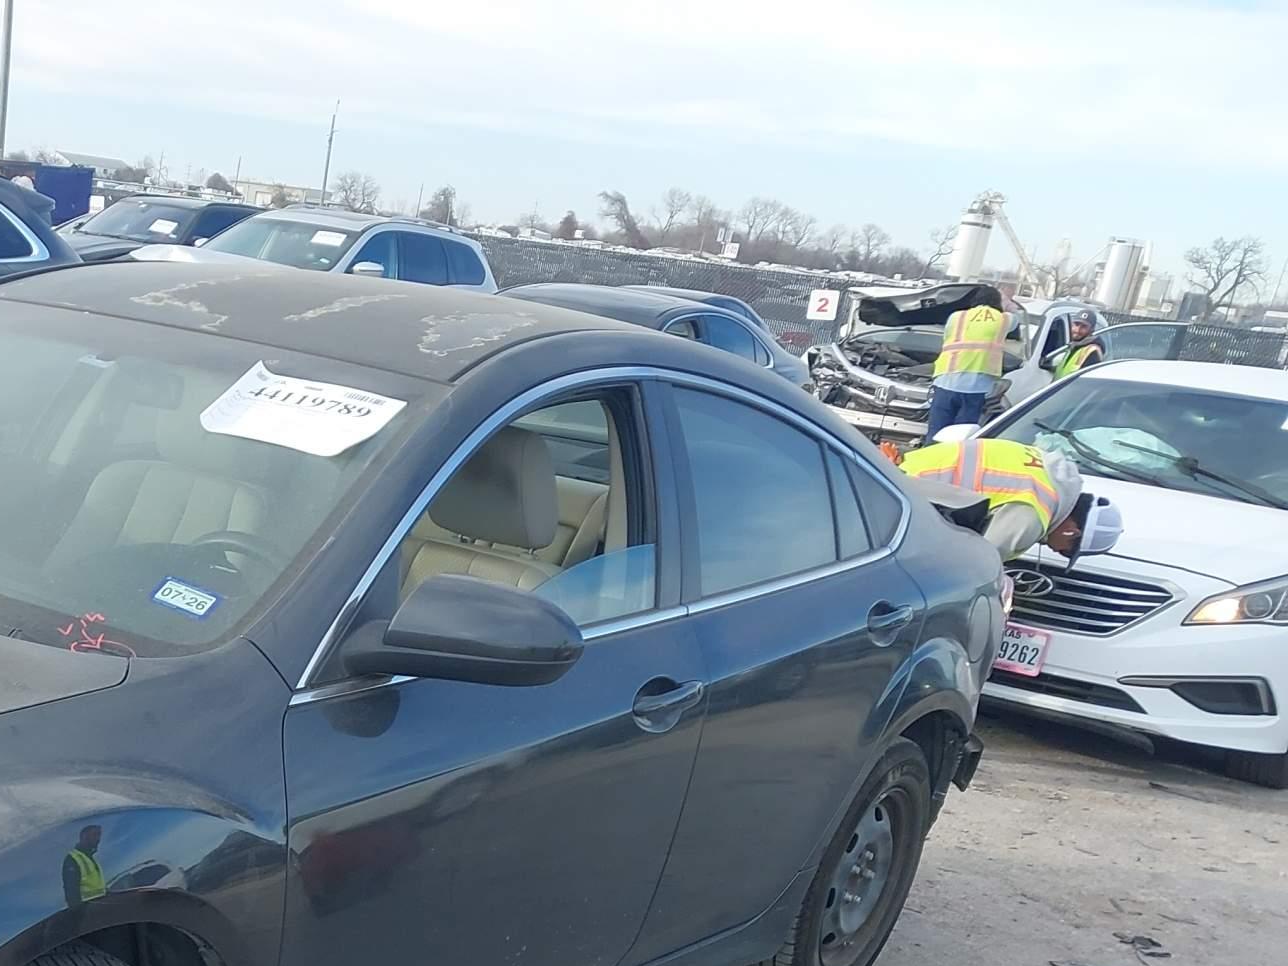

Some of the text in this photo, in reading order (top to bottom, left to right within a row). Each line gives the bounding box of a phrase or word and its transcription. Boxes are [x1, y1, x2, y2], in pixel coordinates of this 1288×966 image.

[816, 297, 829, 312] 2
[249, 386, 372, 418] 44119789
[161, 587, 208, 611] 07 26
[998, 641, 1040, 666] 9262
